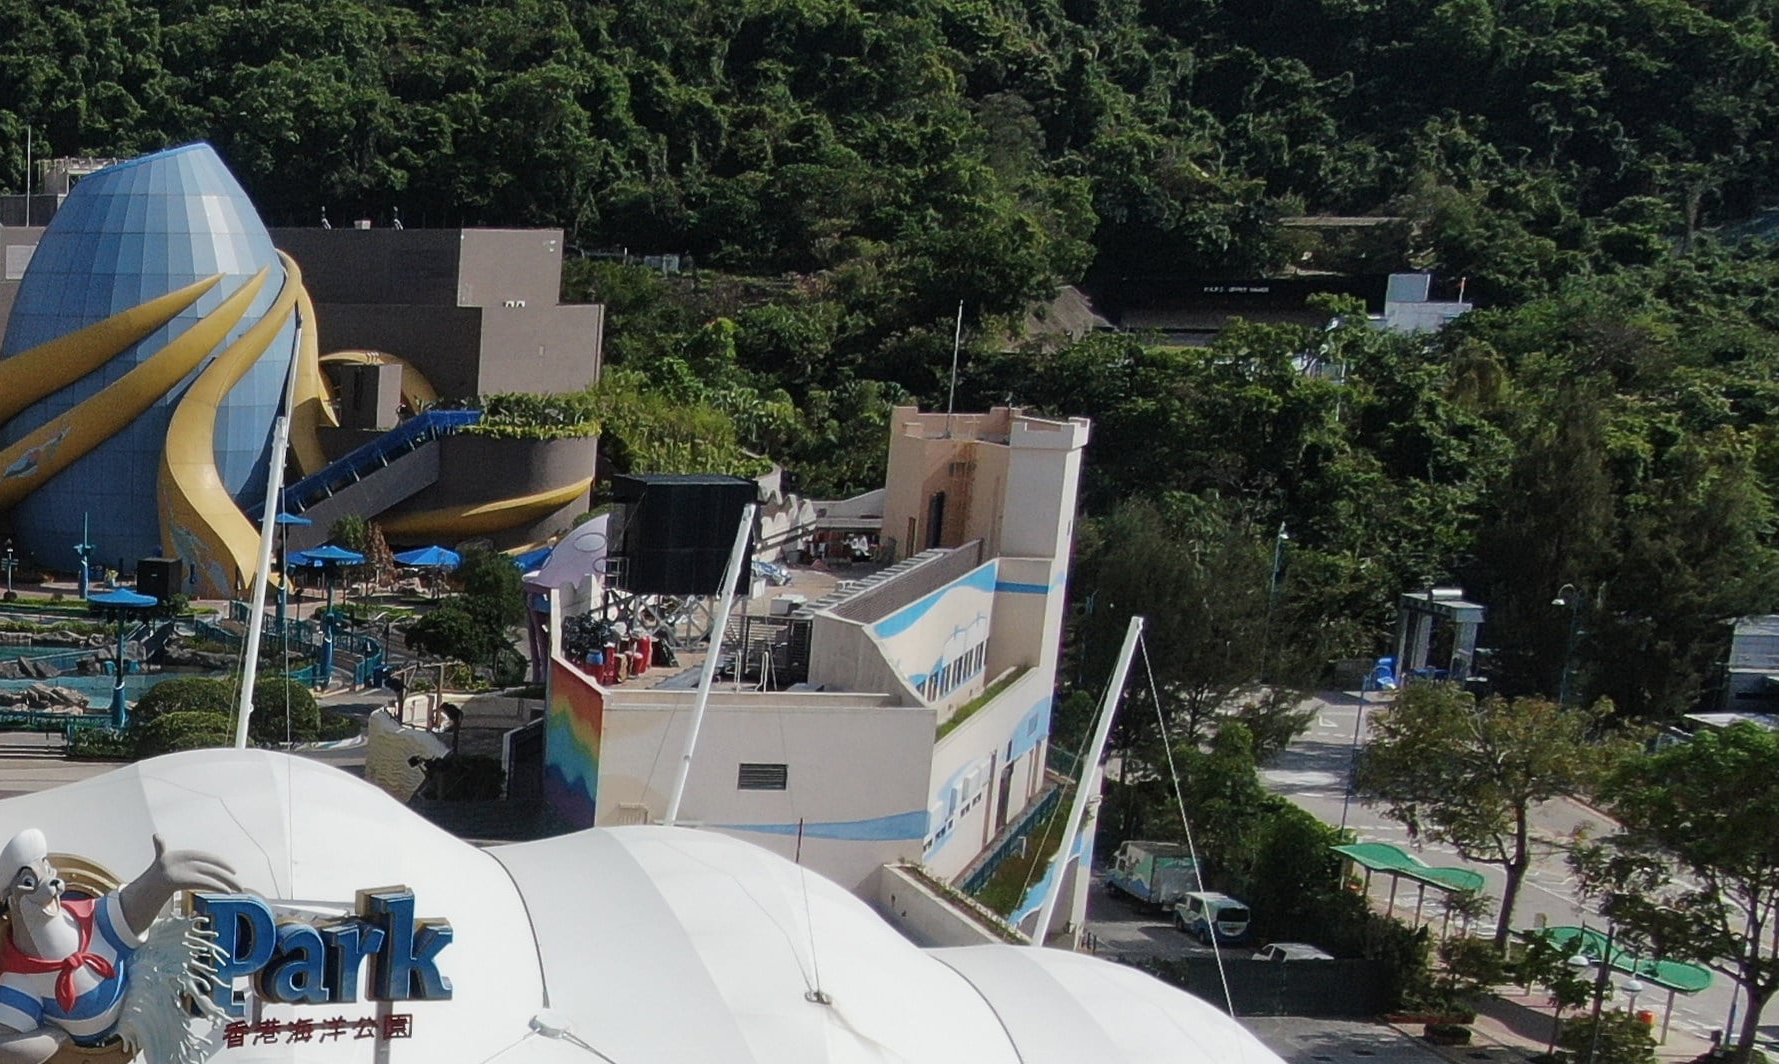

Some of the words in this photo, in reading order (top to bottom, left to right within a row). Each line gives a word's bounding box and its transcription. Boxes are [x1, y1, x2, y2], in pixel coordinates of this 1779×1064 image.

[184, 888, 453, 1018] Park
[223, 1013, 413, 1049] 香港海洋公園
